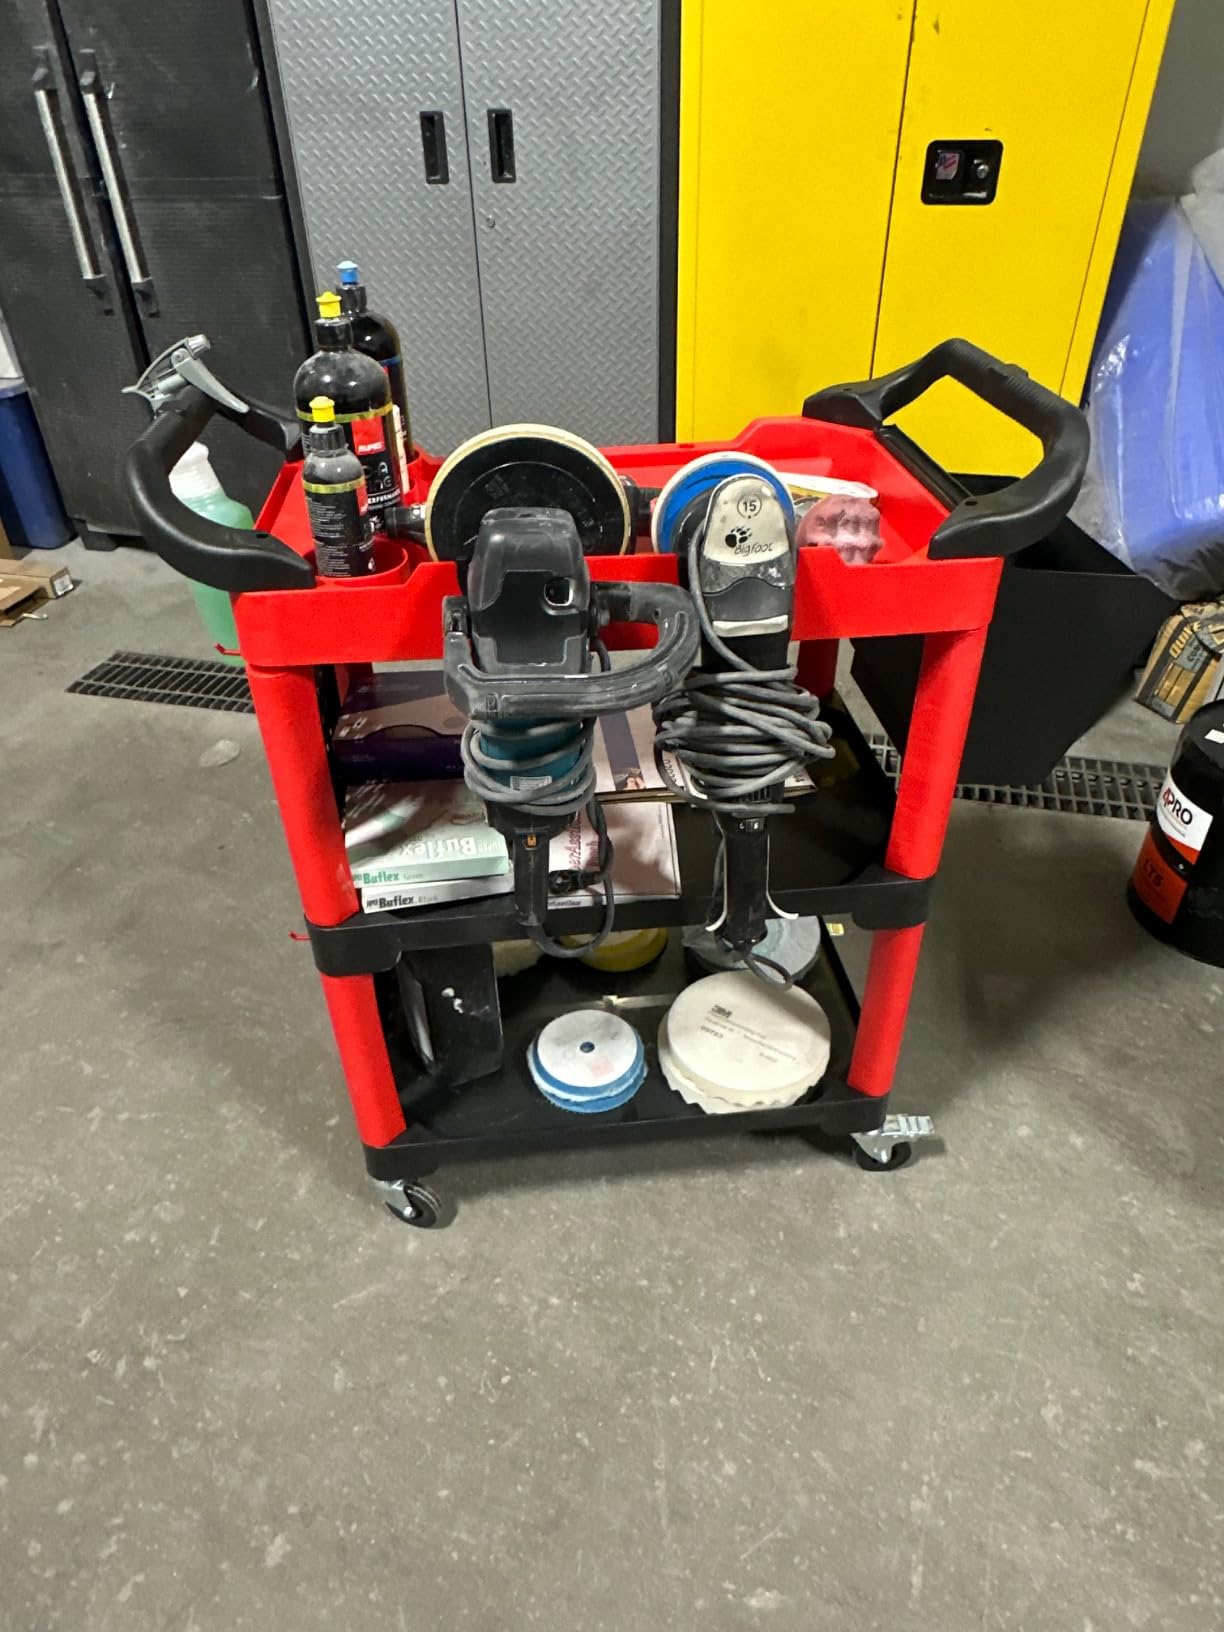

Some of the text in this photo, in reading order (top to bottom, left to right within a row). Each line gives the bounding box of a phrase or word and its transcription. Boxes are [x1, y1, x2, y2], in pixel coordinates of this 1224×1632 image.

[743, 500, 756, 513] 15
[363, 871, 399, 885] Buflex
[379, 895, 414, 909] Buflex
[711, 1005, 733, 1018] 3M
